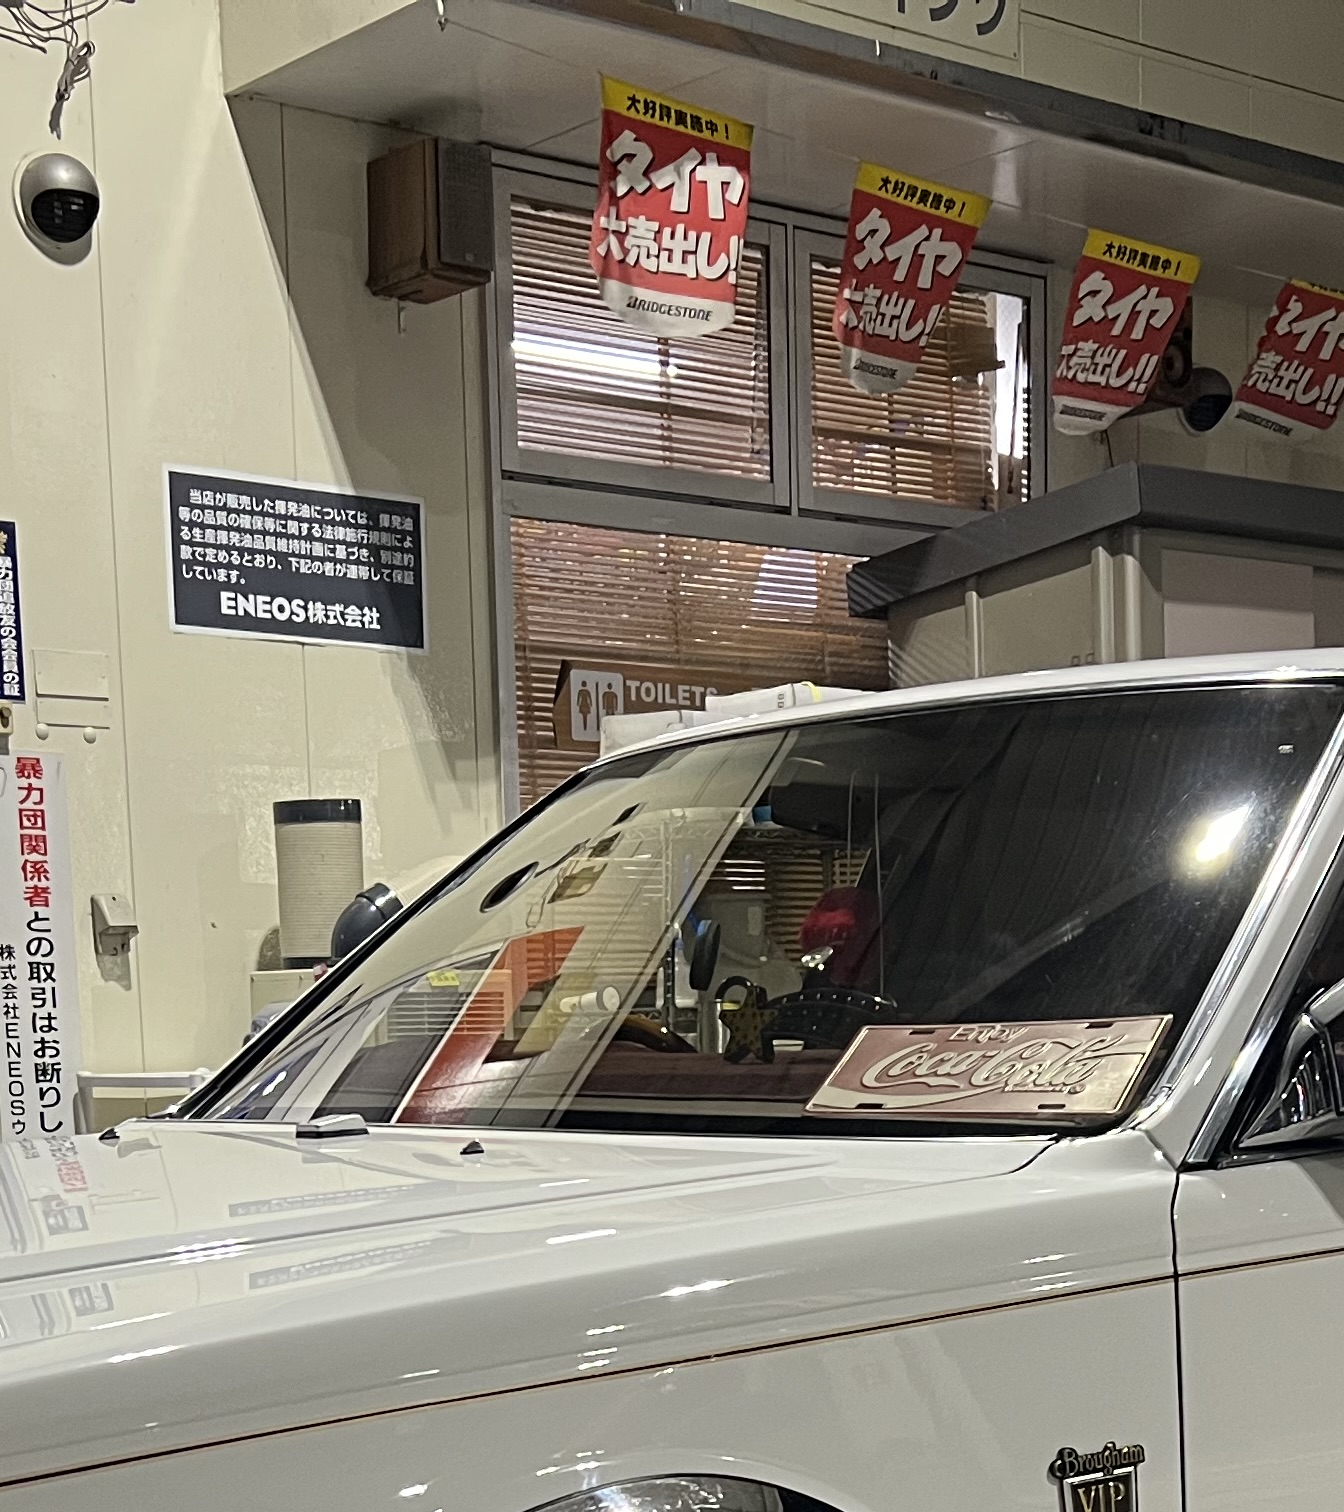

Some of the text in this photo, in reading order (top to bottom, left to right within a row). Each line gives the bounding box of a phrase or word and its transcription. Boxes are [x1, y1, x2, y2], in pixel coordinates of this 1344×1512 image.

[606, 129, 744, 220] タイヤ
[853, 207, 963, 290] タイヤ
[626, 295, 713, 322] BRIDGESTONE
[1072, 270, 1174, 340] タイヤ
[219, 591, 381, 630] ENEOS株式会社
[14, 756, 64, 1134] 暴力団関係者との取引はお断りし
[948, 1025, 1029, 1044] Enjoy
[1051, 1442, 1145, 1478] Brougham
